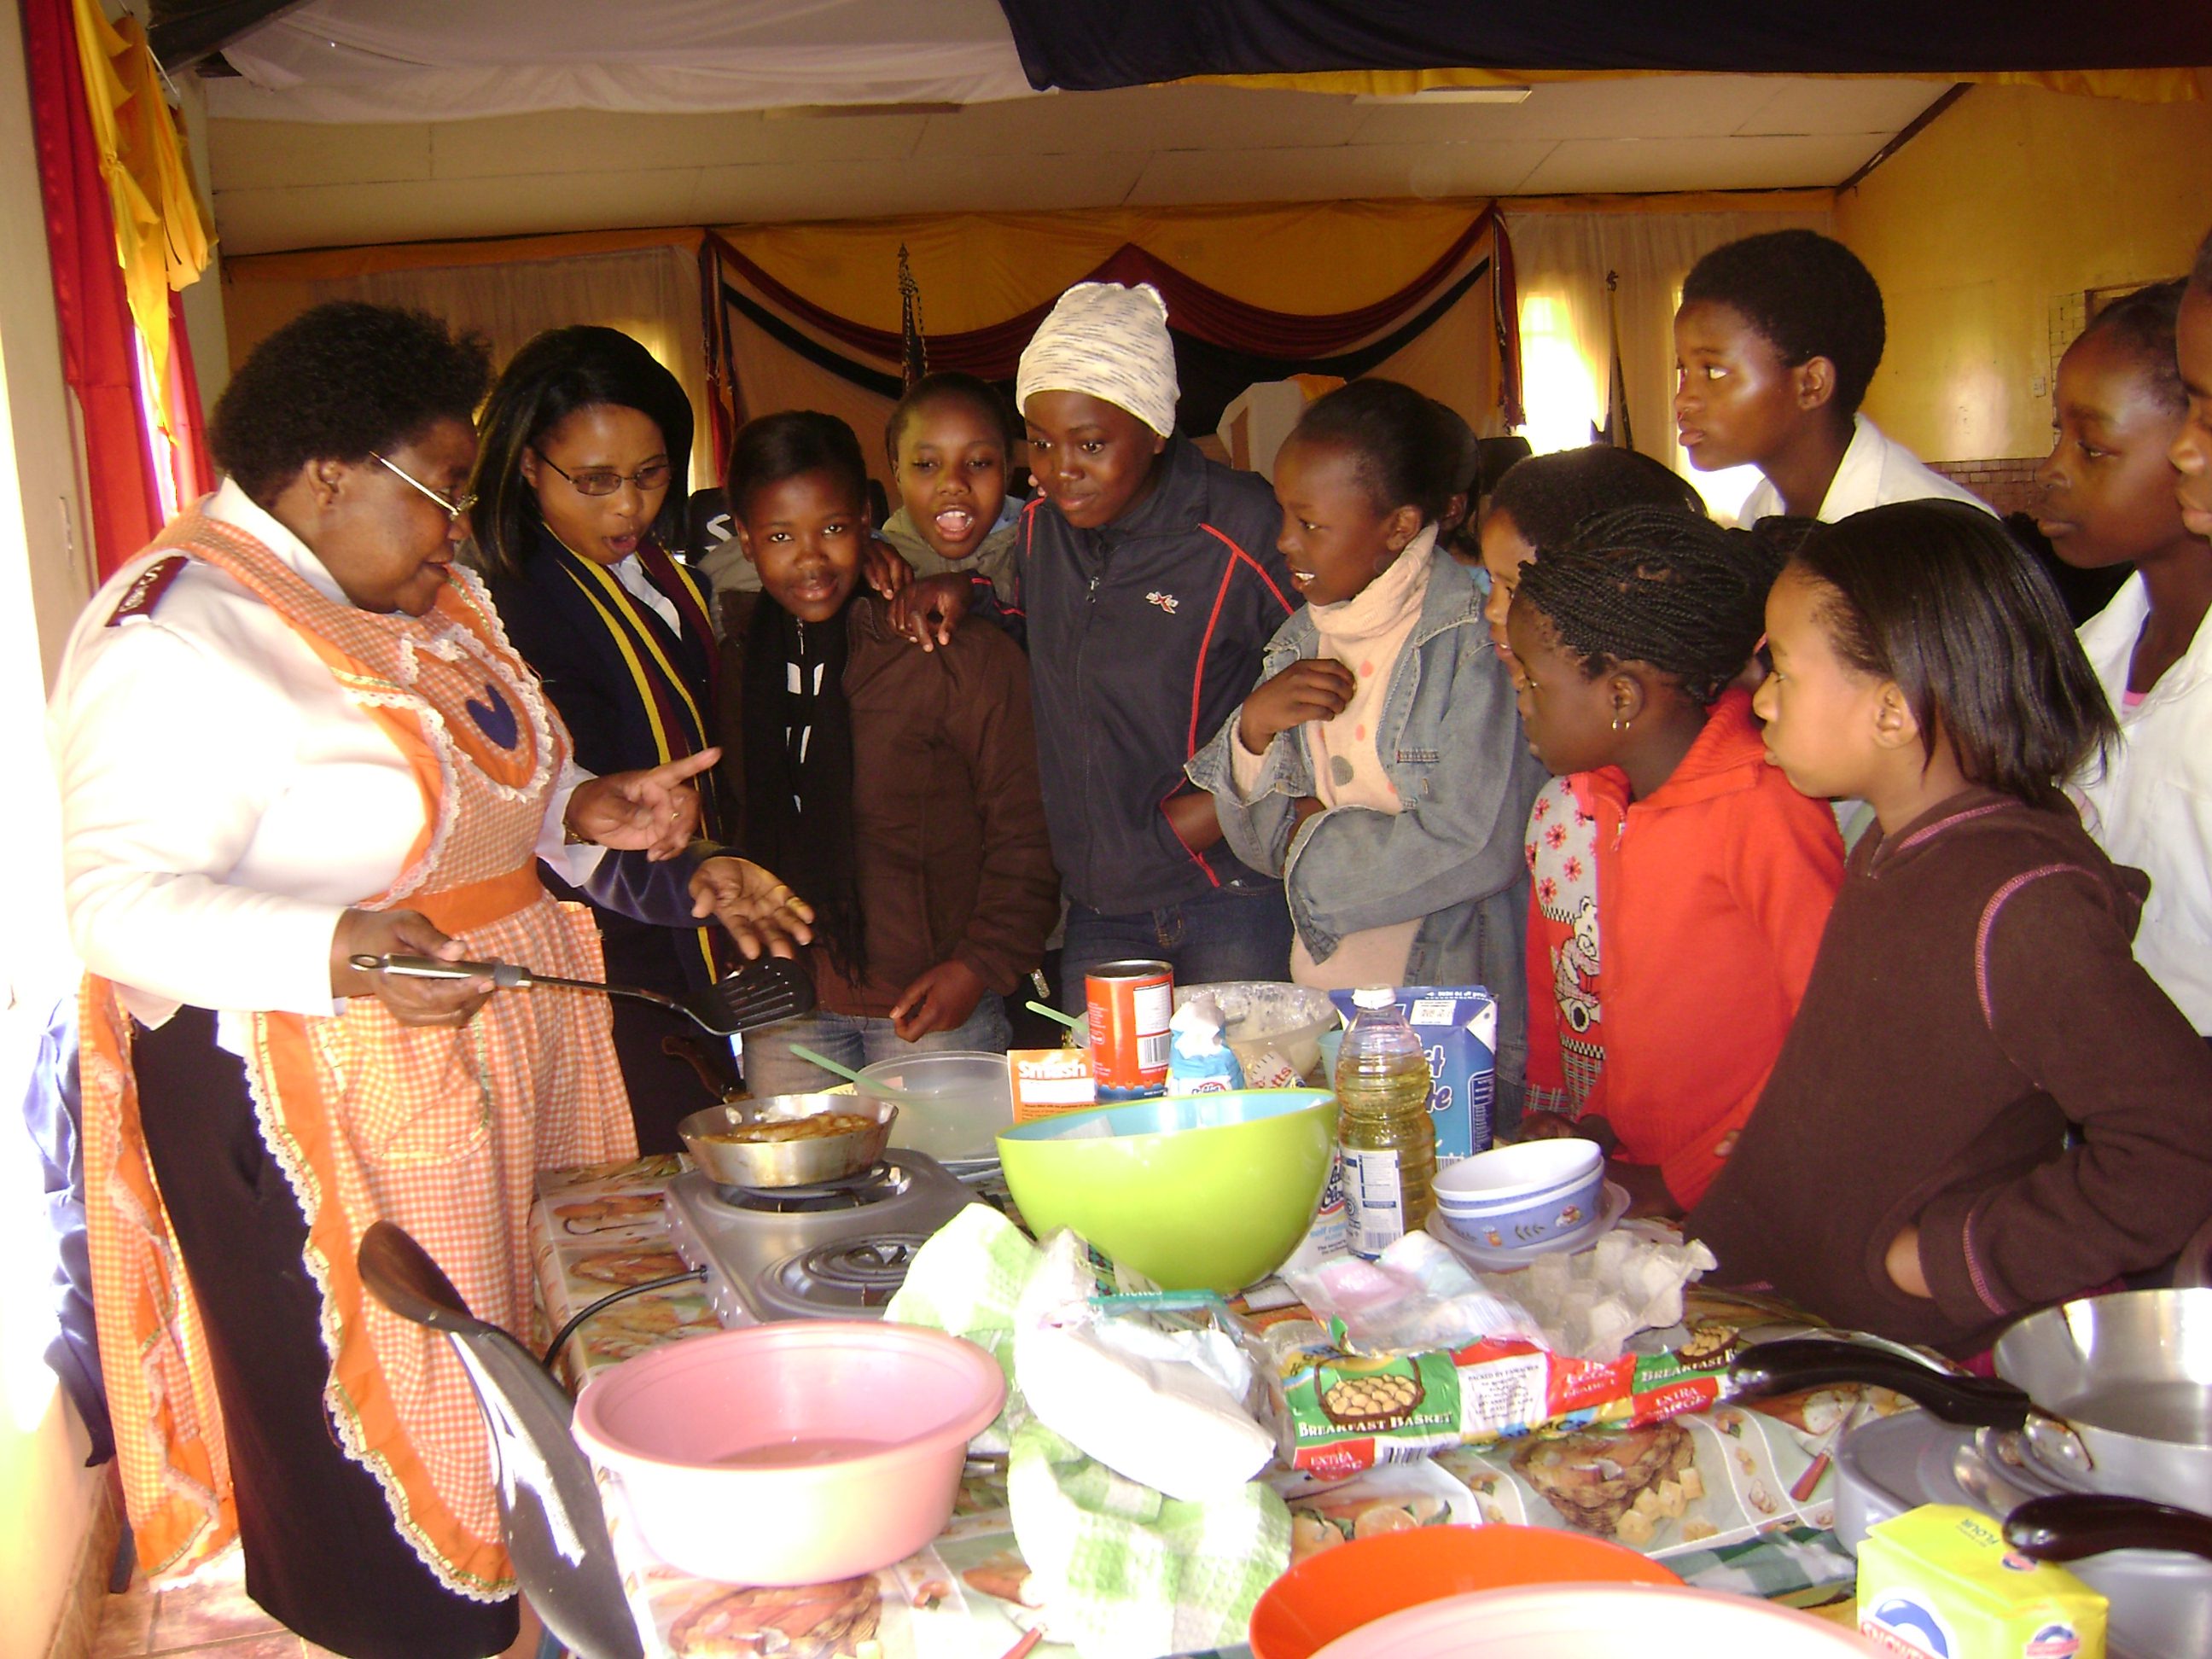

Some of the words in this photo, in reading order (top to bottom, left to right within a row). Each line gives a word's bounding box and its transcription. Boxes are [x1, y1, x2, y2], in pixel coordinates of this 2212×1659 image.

[1018, 1058, 1086, 1078] Smash
[1639, 1356, 1723, 1382] BREAKFAST
[1656, 1387, 1698, 1406] EXTRA
[1298, 1419, 1387, 1437] BREAKFAST
[1390, 1412, 1452, 1428] BASKET
[1310, 1451, 1353, 1465] EXTRA
